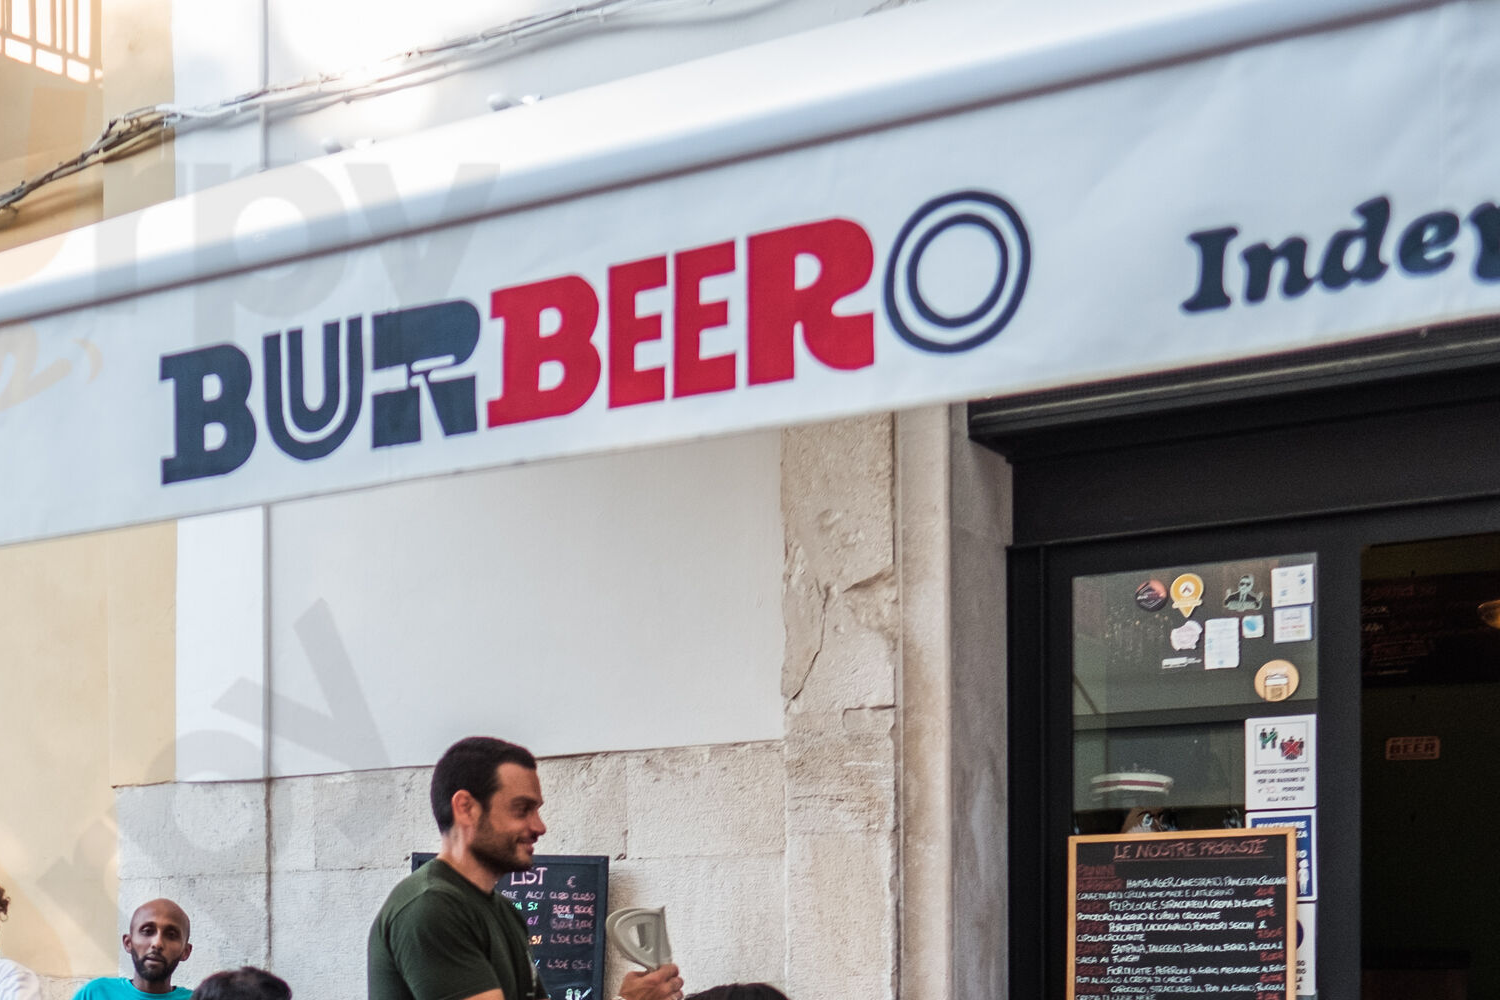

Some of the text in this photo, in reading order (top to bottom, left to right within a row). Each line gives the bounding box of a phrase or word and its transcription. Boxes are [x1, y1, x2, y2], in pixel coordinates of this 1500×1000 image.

[160, 189, 1032, 486] BURBEERO
[1113, 844, 1132, 858] LE
[1136, 842, 1196, 858] NOSTRE
[510, 867, 548, 886] LIST
